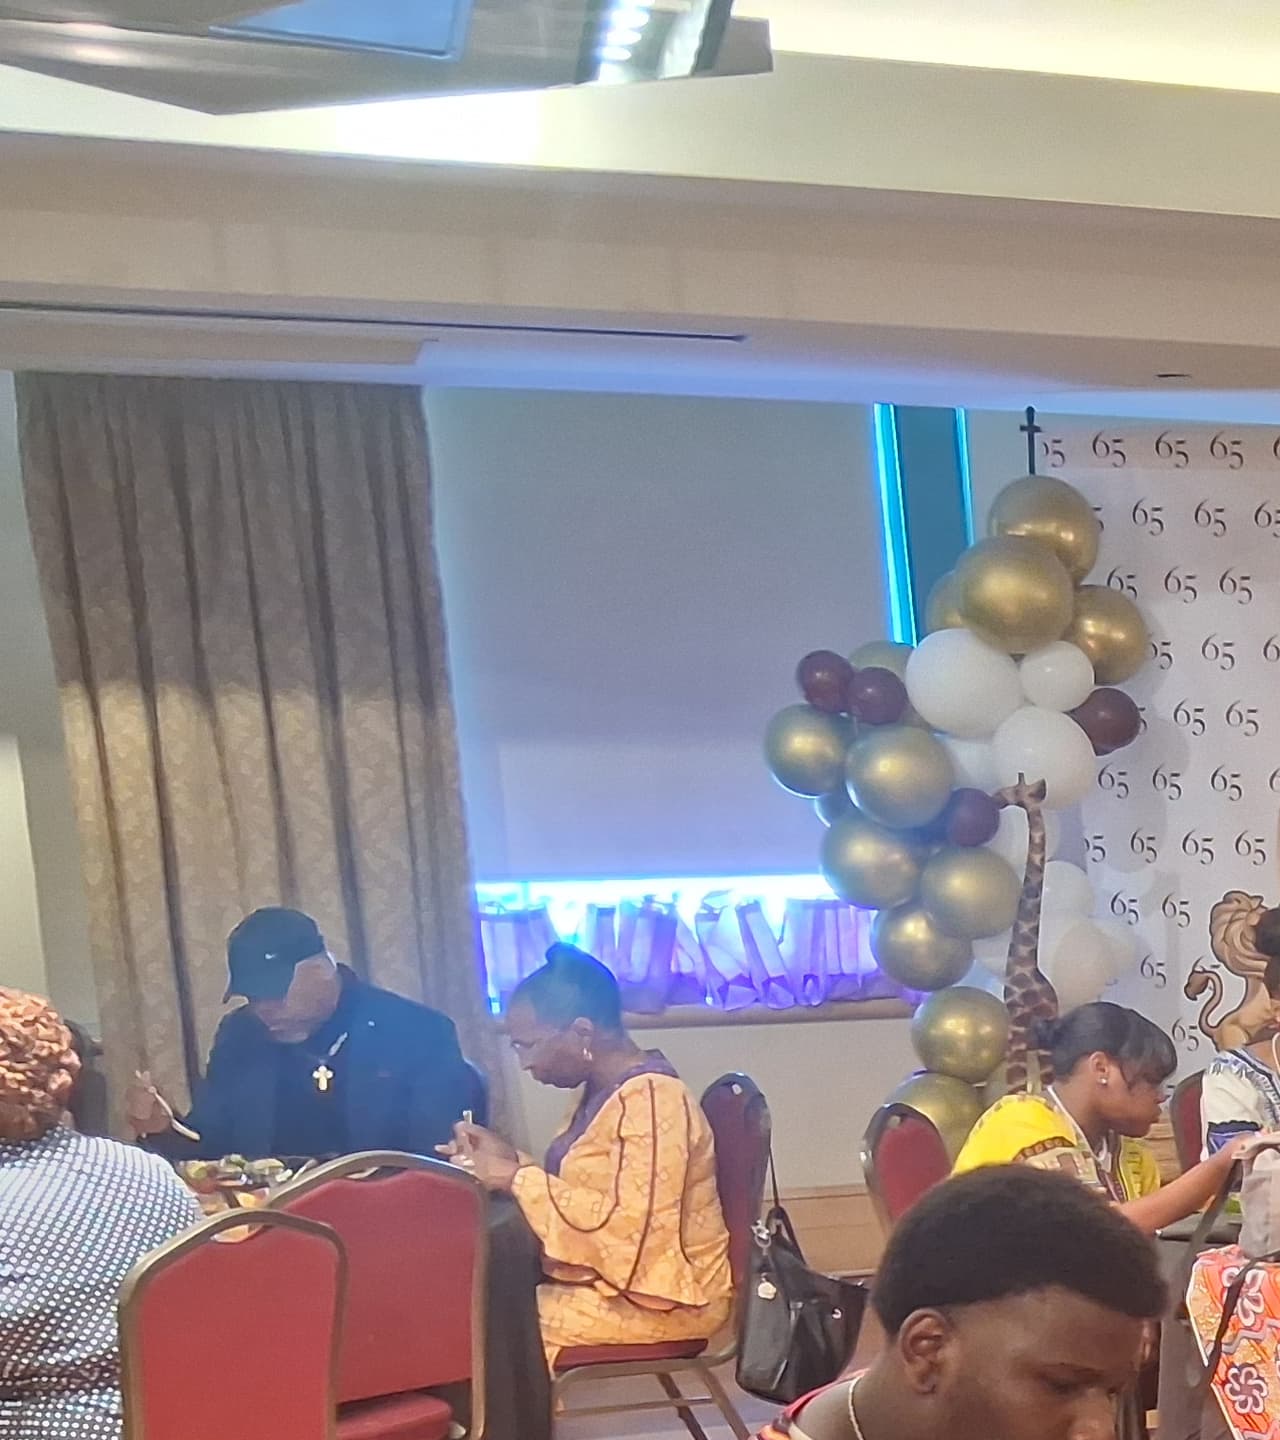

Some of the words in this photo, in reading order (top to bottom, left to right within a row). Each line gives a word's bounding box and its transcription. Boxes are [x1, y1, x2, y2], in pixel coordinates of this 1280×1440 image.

[1092, 432, 1126, 467] 65
[1155, 430, 1189, 468] 65
[1210, 431, 1244, 469] 65
[1132, 499, 1164, 536] 65
[1194, 500, 1226, 537] 65
[1164, 567, 1197, 603] 65
[1219, 569, 1252, 604] 65
[1202, 634, 1235, 670] 65
[1173, 701, 1205, 736] 65
[1226, 701, 1259, 736] 65
[1098, 763, 1129, 799] 65
[1152, 767, 1182, 800] 65
[1211, 766, 1242, 801] 65
[1130, 829, 1157, 864] 65
[1182, 830, 1214, 865] 65
[1235, 831, 1266, 865] 65
[1111, 891, 1139, 925] 65
[1162, 894, 1190, 928] 65
[1140, 952, 1166, 988] 65
[1171, 1017, 1199, 1052] 65
